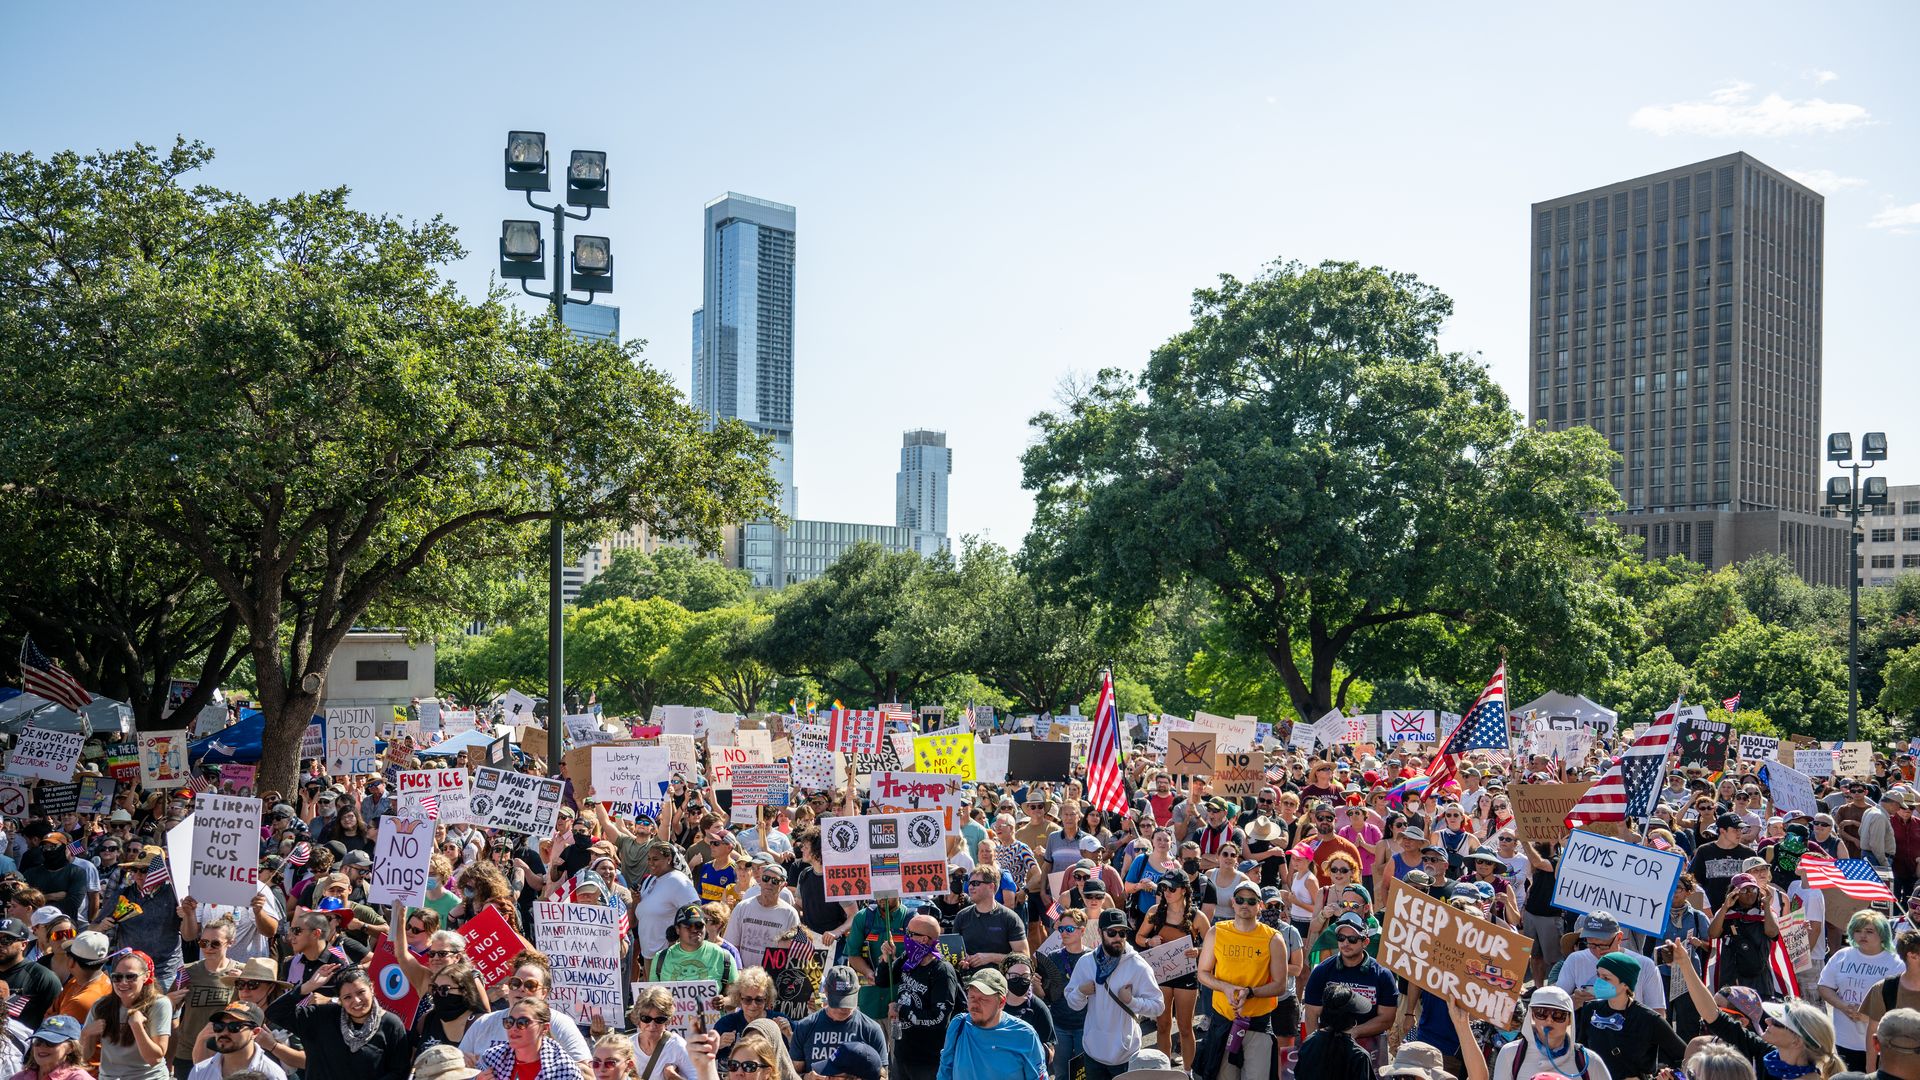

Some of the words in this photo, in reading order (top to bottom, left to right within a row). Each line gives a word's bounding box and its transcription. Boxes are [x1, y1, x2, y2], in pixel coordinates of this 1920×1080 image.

[327, 708, 375, 725] AUSTIN
[333, 726, 346, 740] IS
[349, 725, 371, 739] TOO
[1197, 717, 1214, 728] CALL
[1217, 722, 1226, 730] IT
[1228, 725, 1246, 735] WHAT
[1691, 719, 1727, 733] PROUD
[20, 727, 85, 747] DEMOCRACY
[801, 732, 829, 742] HUMAN
[1388, 733, 1405, 741] NO
[1407, 732, 1436, 742] KINGS
[1700, 731, 1714, 742] OF
[1740, 736, 1779, 750] ABOLISH
[55, 744, 79, 758] FEAR
[328, 739, 359, 757] HOT
[800, 740, 829, 750] RIGHTS
[20, 746, 75, 764] PROTEST
[606, 751, 640, 765] Liberty
[723, 748, 747, 763] NO
[1743, 746, 1771, 760] ICE
[10, 755, 50, 768] DICTATORS
[55, 763, 68, 772] DO
[349, 757, 375, 774] ICE
[669, 761, 689, 772] FUCK
[934, 758, 948, 767] NO
[1226, 754, 1250, 767] NO
[399, 772, 432, 791] FUCK
[437, 771, 463, 788] ICE
[479, 771, 488, 779] NO
[500, 771, 542, 792] MONEY
[1246, 770, 1264, 781] KING
[478, 778, 496, 788] KINGS
[541, 783, 551, 791] NO
[1224, 782, 1255, 794] WAY!
[45, 796, 71, 804] measured
[508, 788, 525, 798] FOR
[540, 790, 558, 800] KINGS
[1516, 789, 1526, 797] THE
[195, 798, 205, 810] I
[404, 796, 415, 807] NO
[495, 795, 533, 814] PEOPLE
[908, 796, 920, 809] 4
[504, 810, 522, 819] NOT
[1532, 816, 1542, 824] NOT
[487, 815, 554, 837] PARADES!!!
[871, 824, 883, 834] NO
[210, 830, 242, 846] HOT
[871, 834, 896, 845] KINGS
[206, 846, 238, 862] CUS
[389, 836, 419, 859] NO
[1566, 839, 1619, 868] MOMS
[1622, 854, 1663, 881] FOR
[192, 860, 227, 879] FUCK
[371, 860, 425, 892] Kings
[828, 867, 867, 880] RESIST!
[903, 863, 944, 876] RESIST!
[1559, 877, 1663, 920] HUMANITY
[539, 902, 565, 922] HEY
[567, 905, 614, 925] MEDIA!
[762, 919, 783, 929] SECURITY
[1393, 888, 1451, 937] KEEP
[1455, 913, 1512, 962] YOUR
[541, 926, 554, 937] AM
[553, 926, 566, 938] NOT
[572, 926, 590, 937] PAID
[474, 931, 500, 954] NOT
[1387, 919, 1432, 960] DIC
[1434, 941, 1466, 958] away
[487, 946, 506, 962] US
[538, 940, 560, 951] BUT
[563, 940, 568, 951] I
[570, 940, 590, 954] AM
[590, 942, 599, 953] A
[1166, 943, 1191, 960] Justice
[1222, 944, 1263, 960] LGBTQ+
[581, 954, 619, 970] AMERICAN
[763, 948, 787, 970] NO
[1431, 955, 1456, 972] this
[1432, 948, 1464, 965] from
[564, 969, 615, 986] DEMANDS
[1383, 940, 1462, 1002] TATOR
[1847, 976, 1866, 989] THE
[582, 988, 623, 1006] JUSTICE
[814, 1031, 857, 1045] PUBLIC
